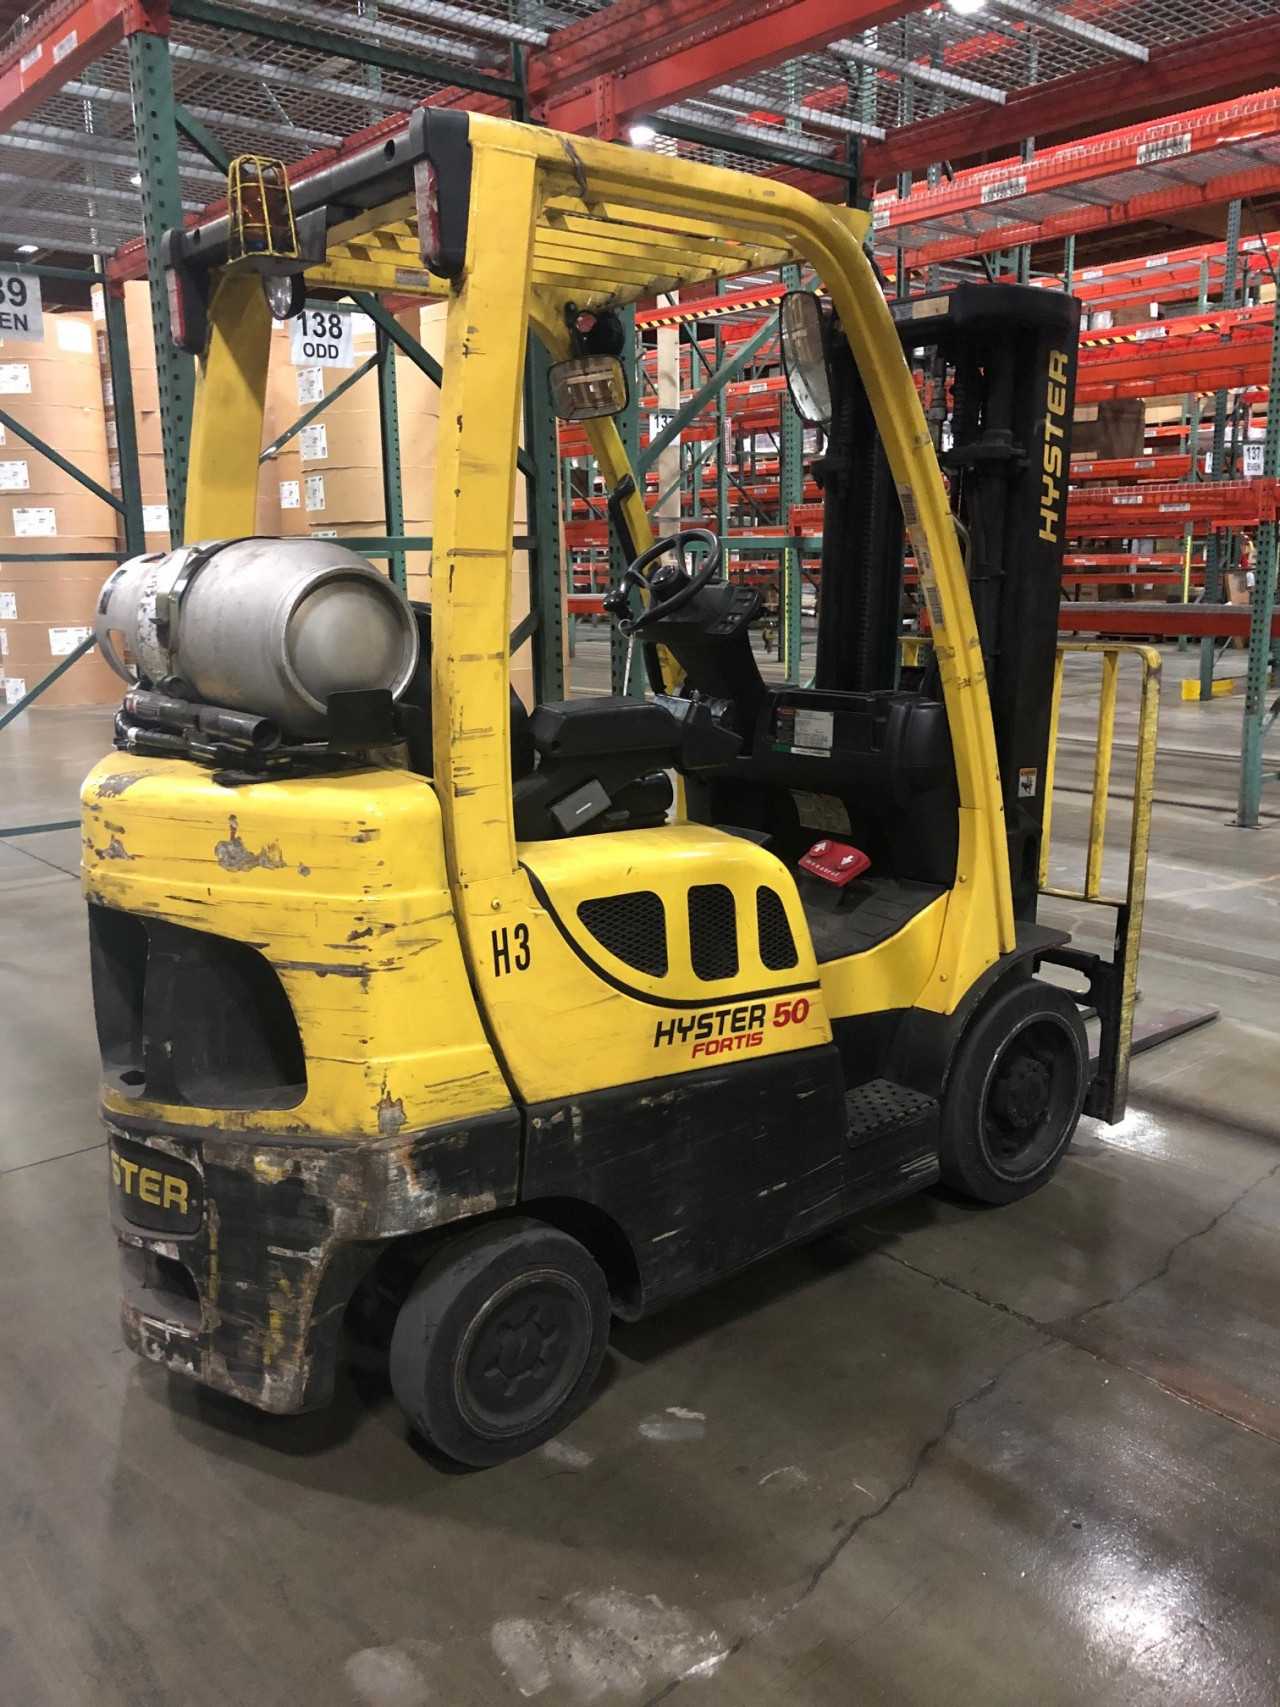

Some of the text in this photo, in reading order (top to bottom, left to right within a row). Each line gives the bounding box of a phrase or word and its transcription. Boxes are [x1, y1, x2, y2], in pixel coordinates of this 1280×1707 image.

[297, 311, 343, 339] 138
[303, 342, 339, 360] ODD
[1039, 351, 1069, 543] HYSTER
[491, 923, 531, 977] H3
[654, 998, 810, 1048] HYSTER 50
[692, 1031, 764, 1059] FORTIS
